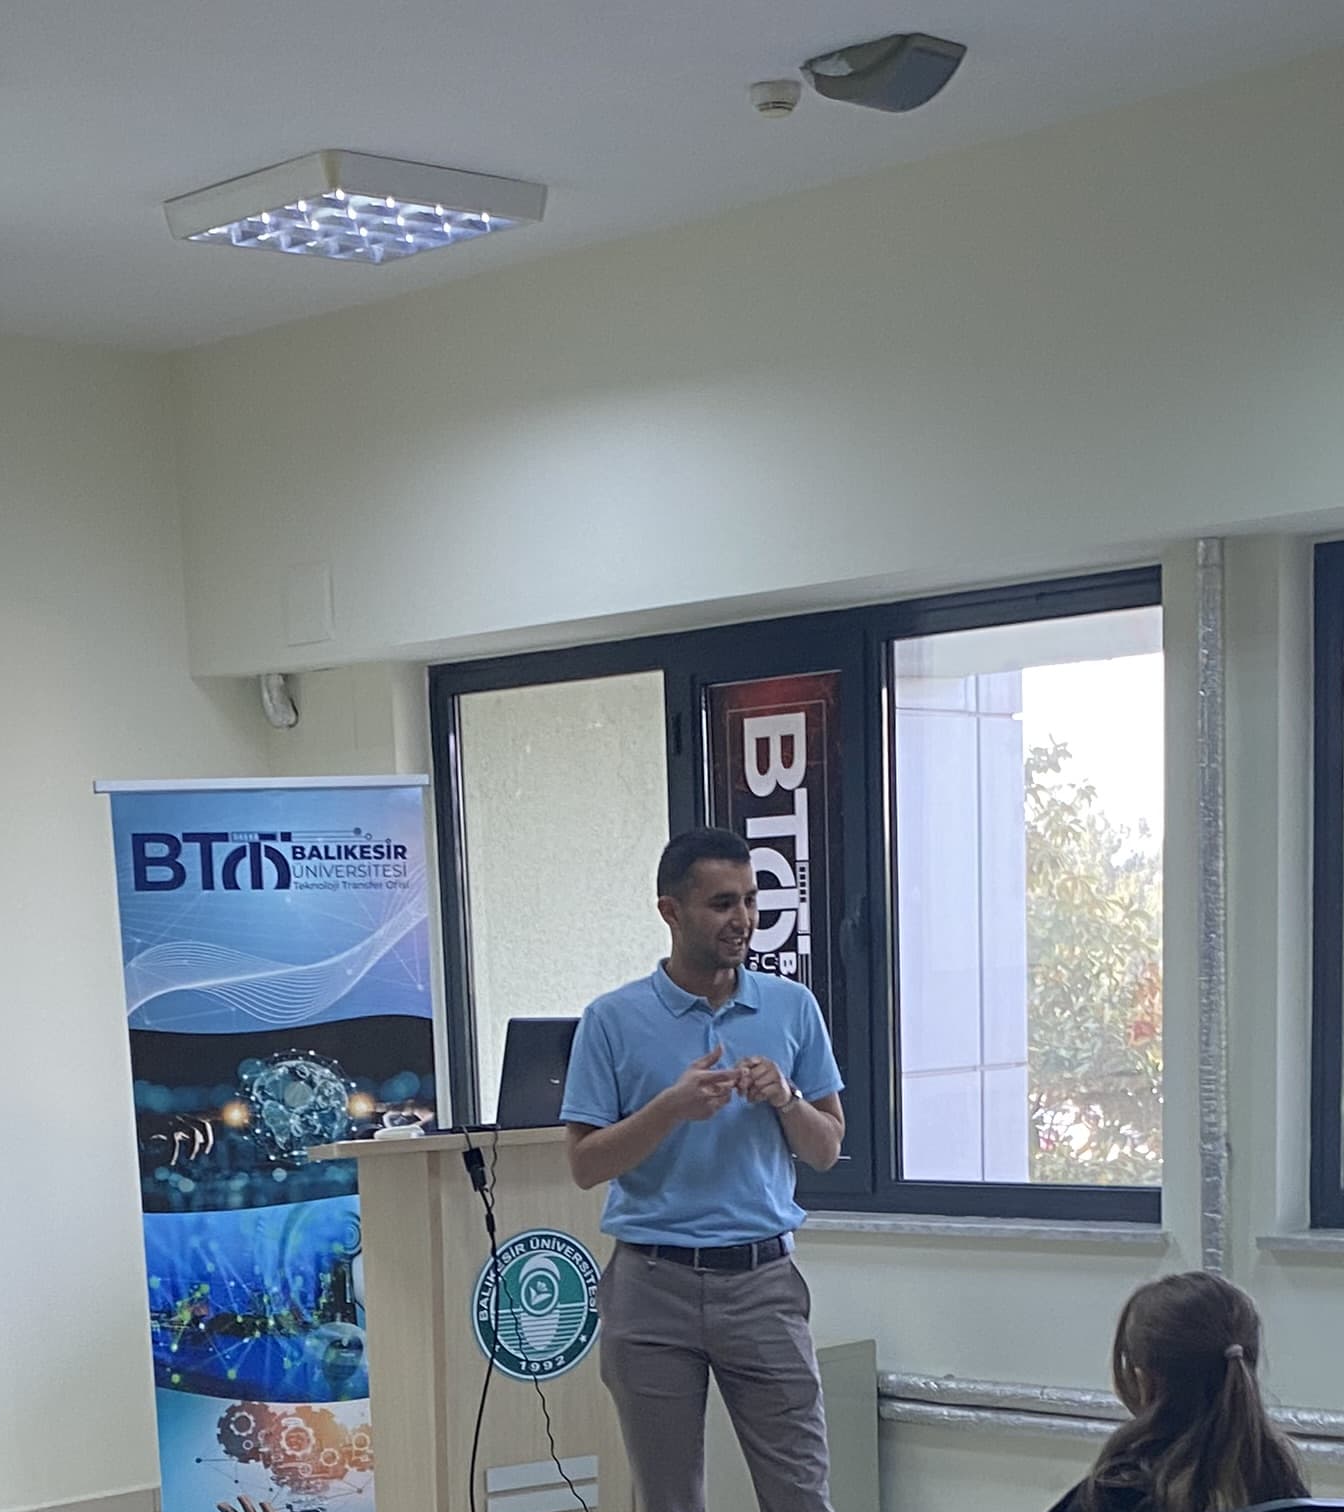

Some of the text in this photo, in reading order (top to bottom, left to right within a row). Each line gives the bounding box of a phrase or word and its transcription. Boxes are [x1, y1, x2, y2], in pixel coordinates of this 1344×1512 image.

[291, 839, 407, 860] BALIKESİR
[292, 862, 407, 879] ÜNİVERSİTESİ
[519, 1355, 566, 1372] 1992
